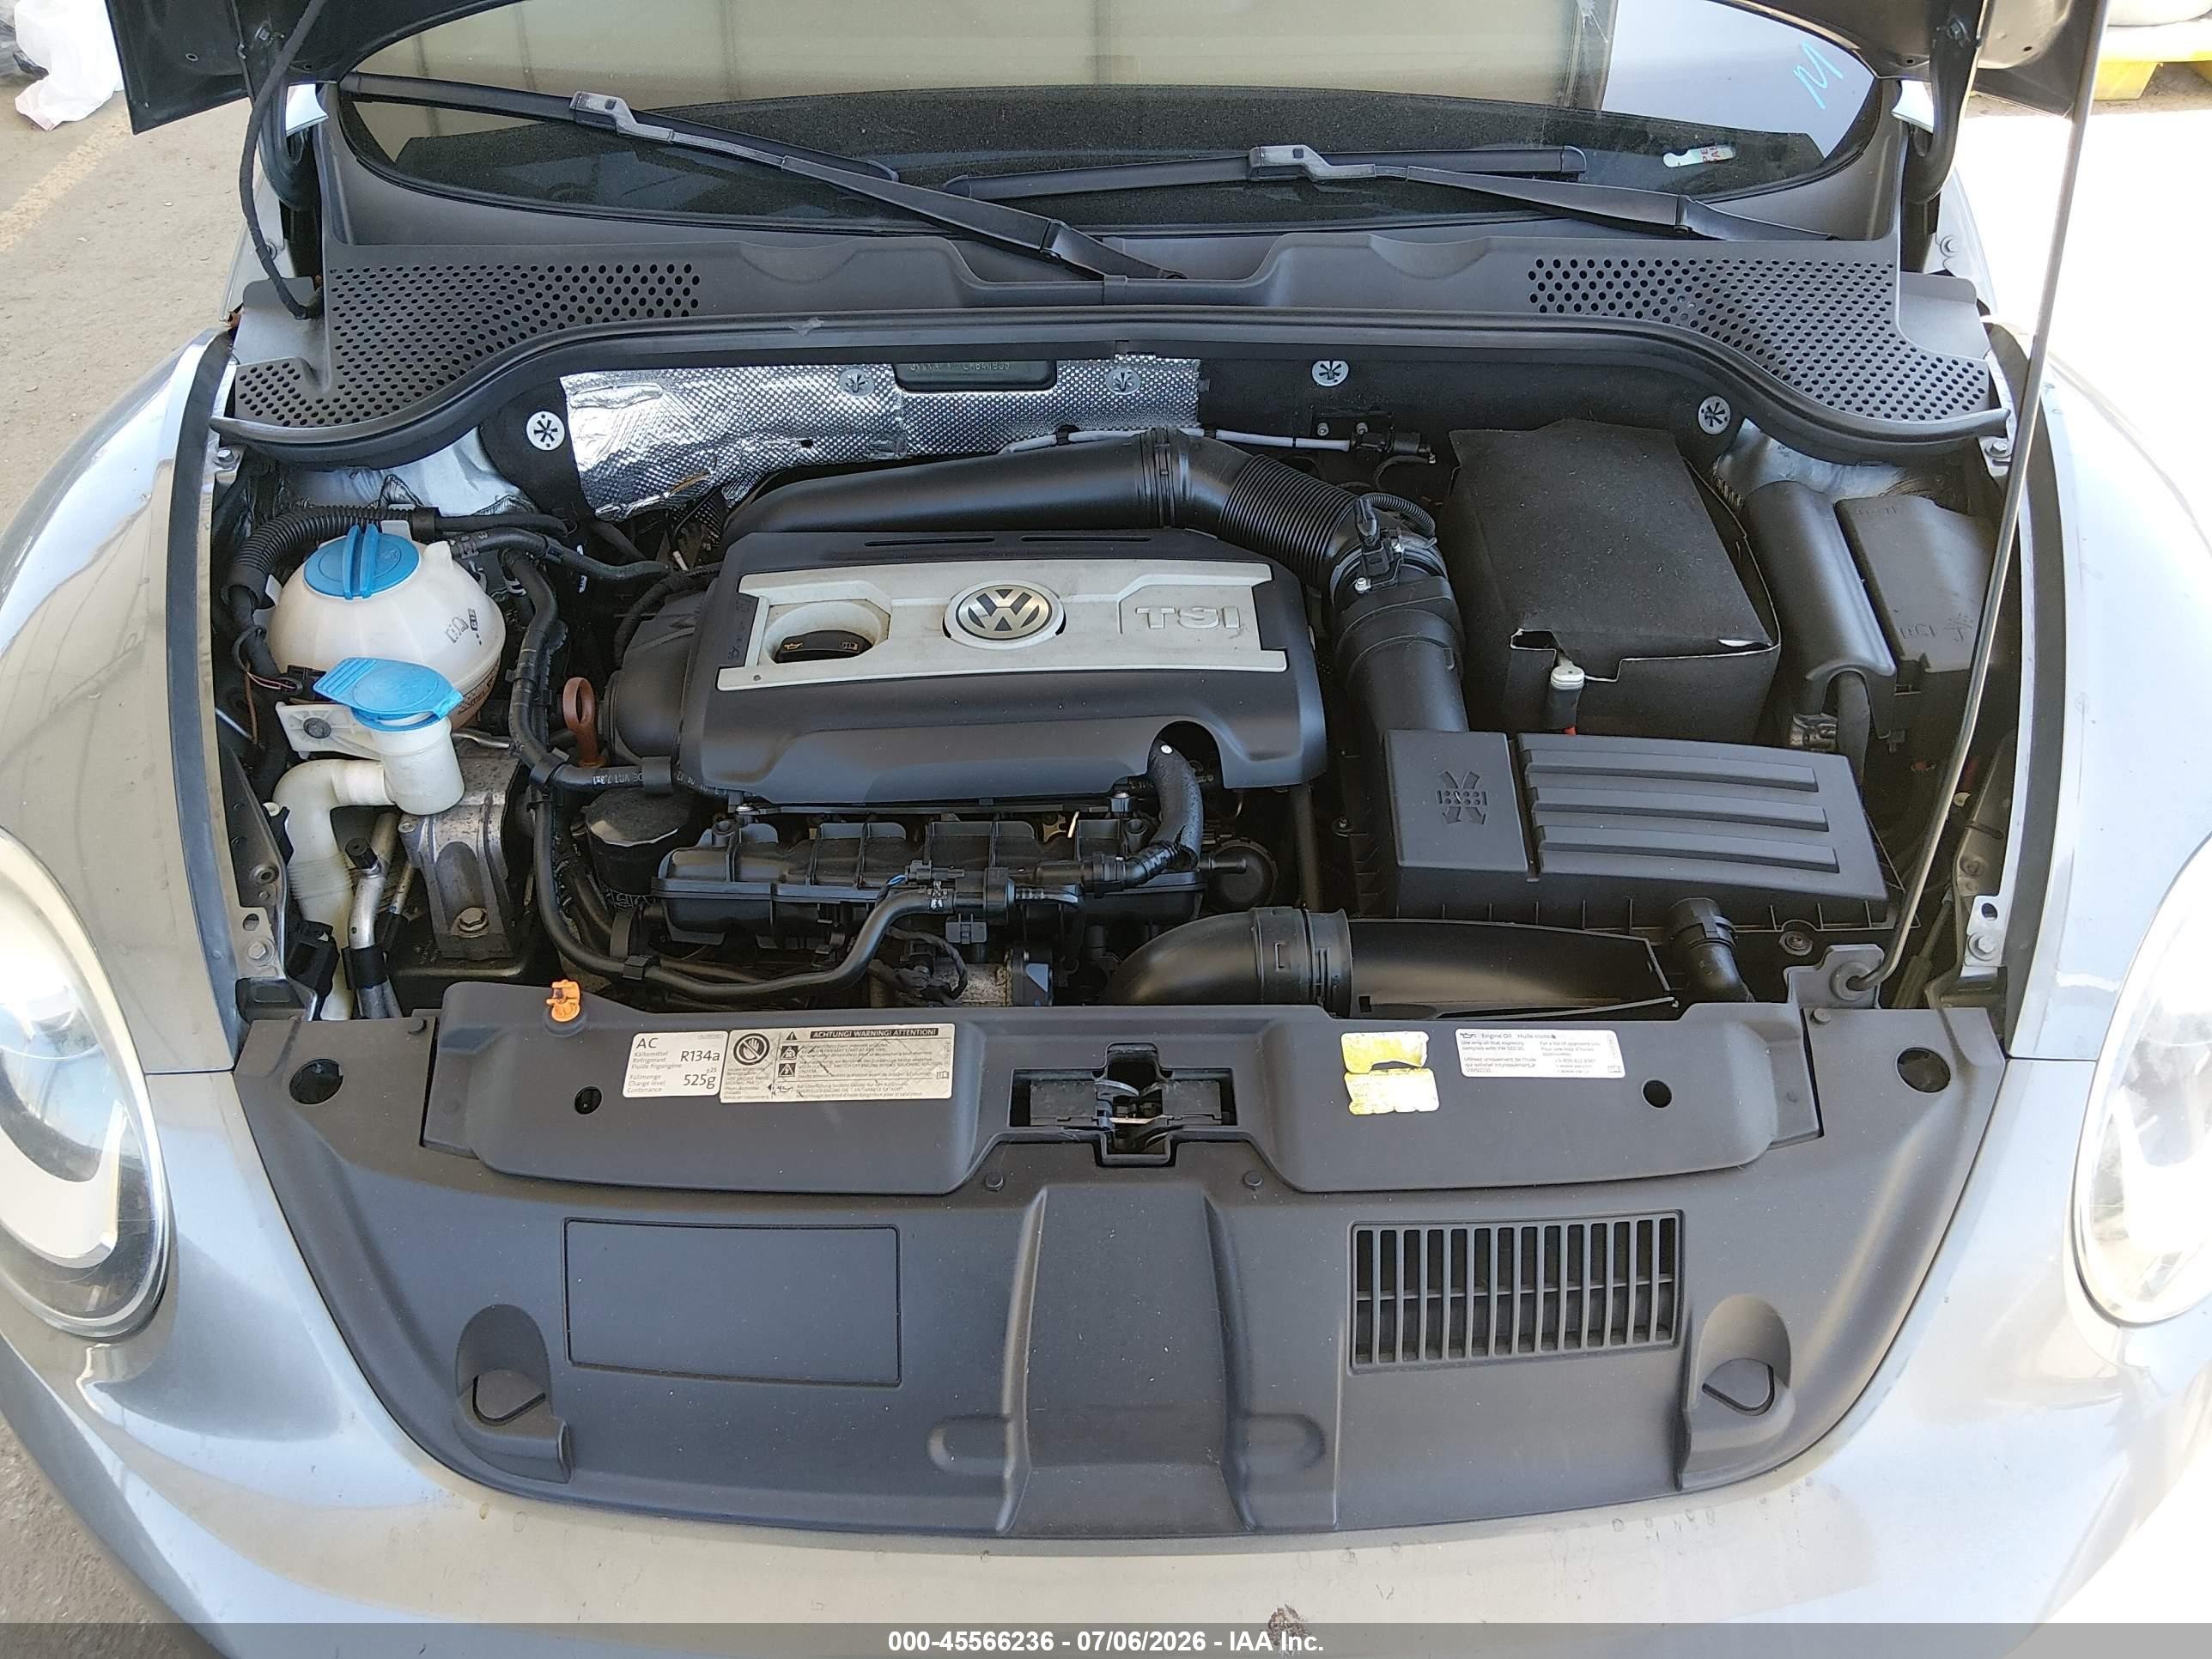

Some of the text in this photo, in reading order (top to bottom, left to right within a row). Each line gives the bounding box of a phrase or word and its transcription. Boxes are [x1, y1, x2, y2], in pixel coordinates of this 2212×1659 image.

[1135, 605, 1241, 629] TSI
[635, 1037, 659, 1049] AC
[680, 1050, 720, 1062] R134a
[683, 1073, 716, 1090] 525g
